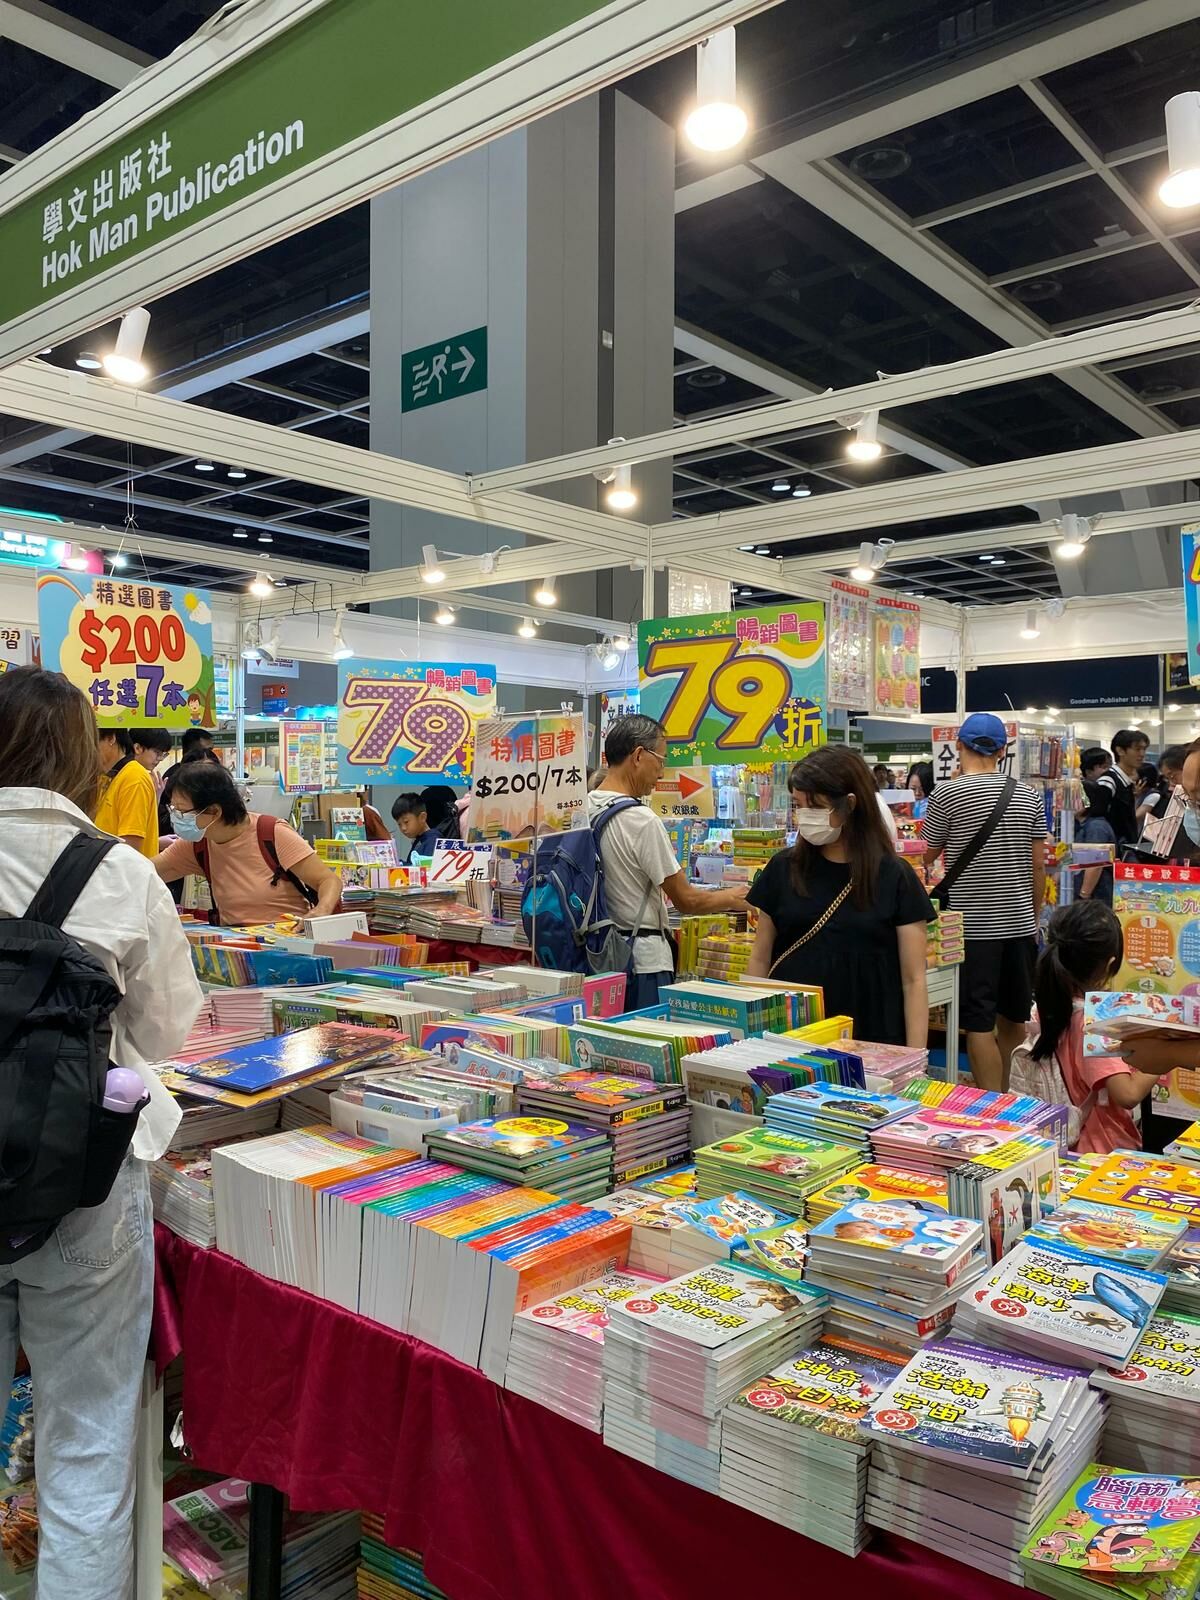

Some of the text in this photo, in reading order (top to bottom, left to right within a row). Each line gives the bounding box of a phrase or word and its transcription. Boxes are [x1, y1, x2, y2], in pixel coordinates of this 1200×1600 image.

[43, 131, 172, 244] 學文出版社
[42, 119, 304, 288] Hok Man Publication
[96, 581, 173, 611] 精選圖書
[78, 609, 186, 673] $200
[736, 612, 820, 645] 暢銷圖書
[88, 664, 188, 717] 任選7本
[426, 668, 492, 694] 暢銷圖書
[645, 634, 822, 750] 79 折
[343, 677, 471, 773] 79
[490, 727, 576, 763] 特價圖書
[475, 764, 583, 798] $200/7本
[432, 850, 474, 881] 79
[681, 1276, 745, 1302] 恐龍
[1018, 1265, 1090, 1293] 海洋
[651, 1291, 748, 1328] 史前世界
[1001, 1283, 1072, 1312] 奧妙
[793, 1360, 864, 1387] 神奇
[812, 1351, 850, 1366] 探索
[769, 1377, 870, 1412] 大自然
[906, 1369, 990, 1399] 浩瀚
[894, 1392, 966, 1422] 宇宙
[1094, 1476, 1171, 1496] 腦筋
[1085, 1491, 1200, 1520] 急轉彎
